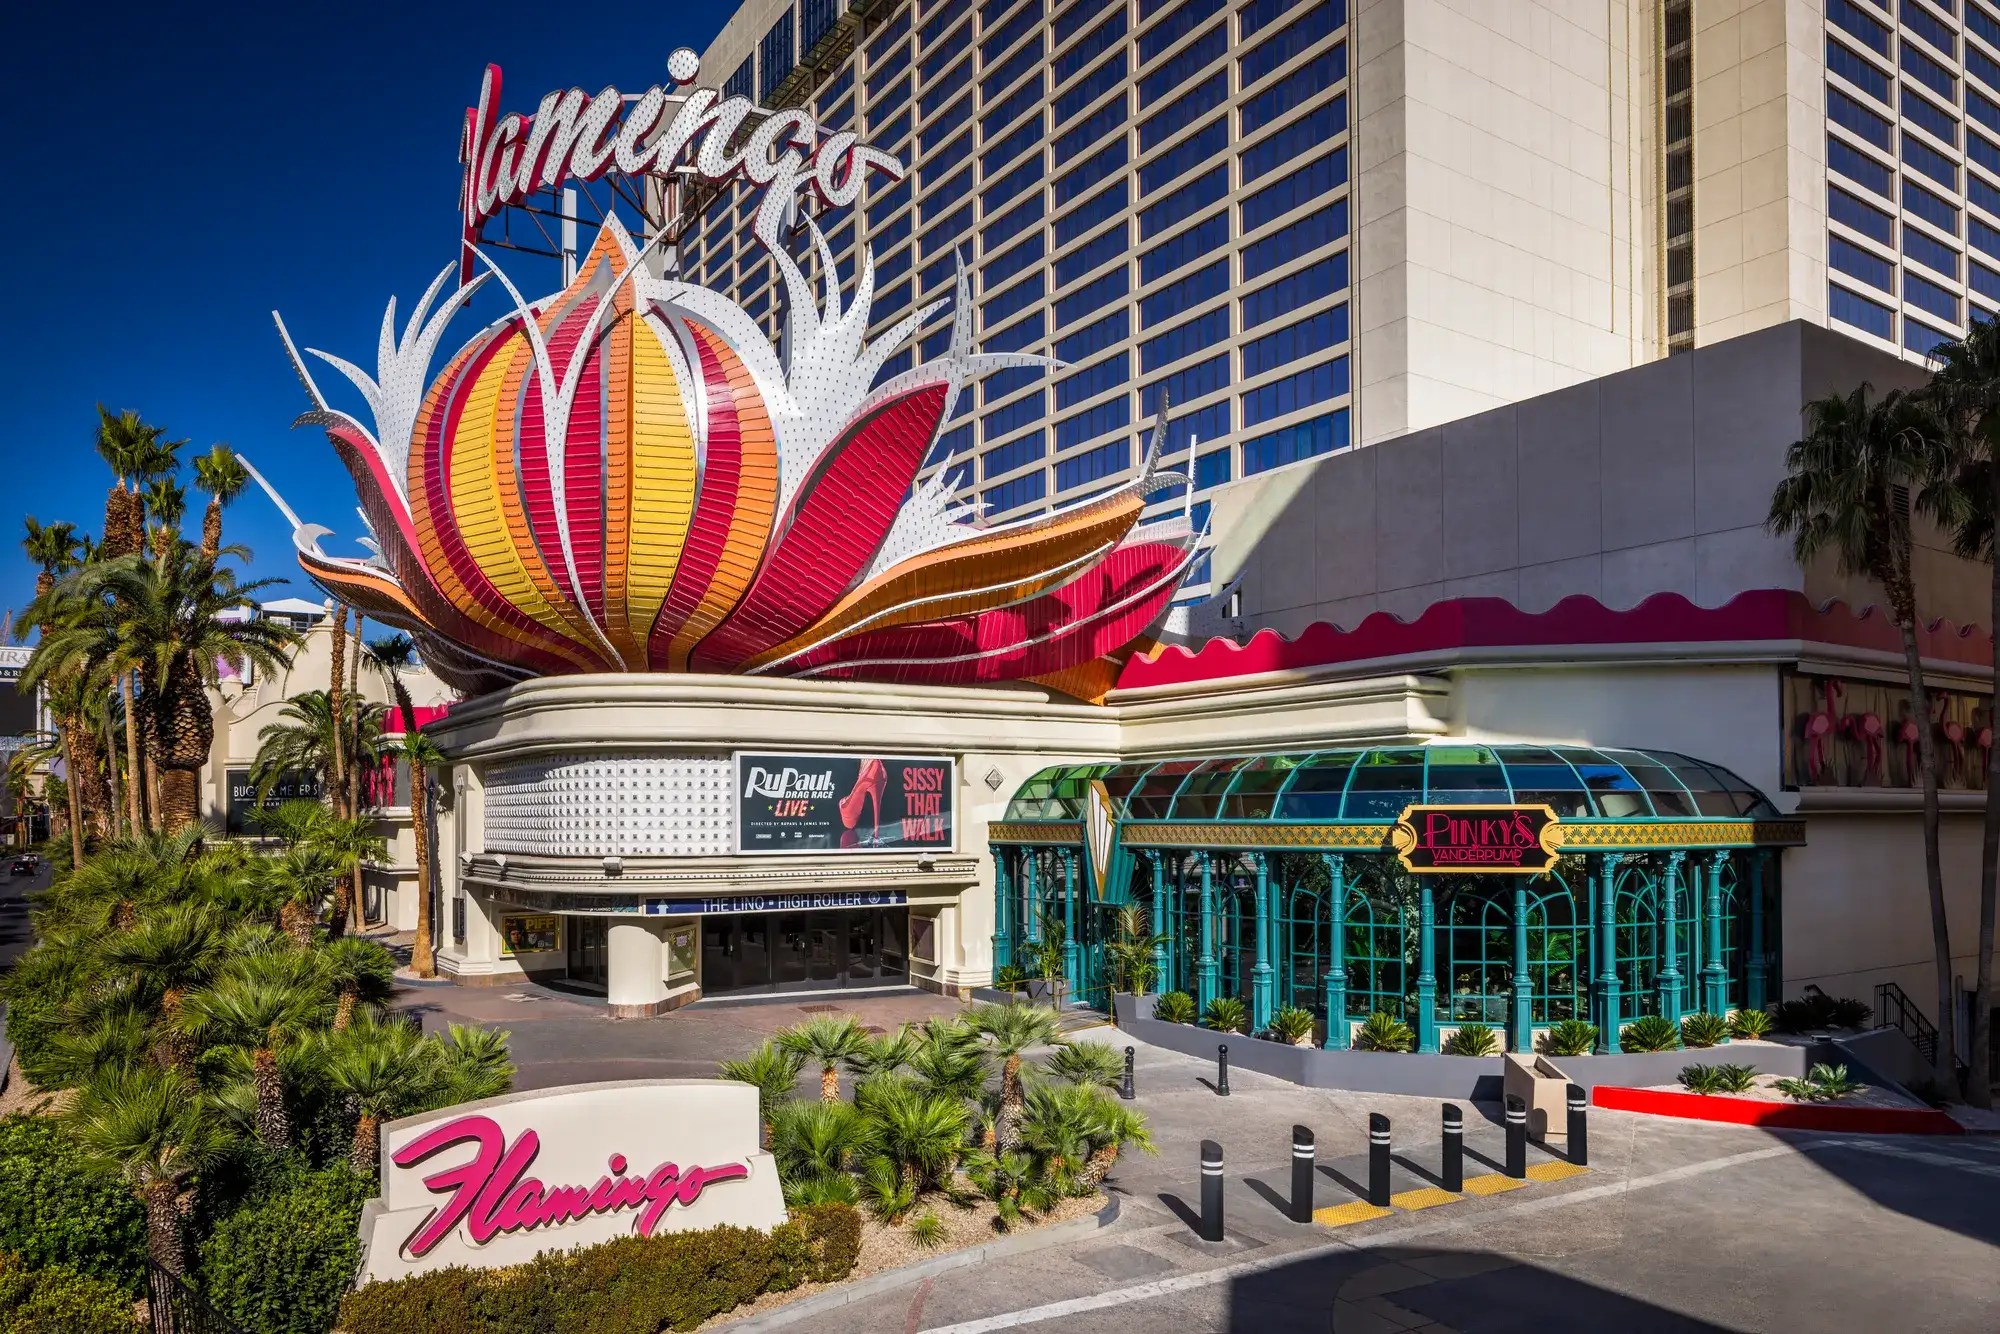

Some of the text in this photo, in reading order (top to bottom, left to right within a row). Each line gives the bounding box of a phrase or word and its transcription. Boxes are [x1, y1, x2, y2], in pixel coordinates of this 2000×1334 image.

[902, 766, 944, 791] SISSY
[784, 790, 834, 799] DRAG RACE
[904, 792, 942, 816] THAT
[774, 799, 809, 817] LIVE
[901, 817, 945, 841] WALK
[1423, 810, 1536, 849] PINKY'S
[1432, 848, 1523, 862] VANDERPUMP
[701, 892, 862, 914] THE LINQ HIGH ROLLER
[525, 917, 554, 930] PIFF
[390, 1114, 749, 1258] Flamingo
